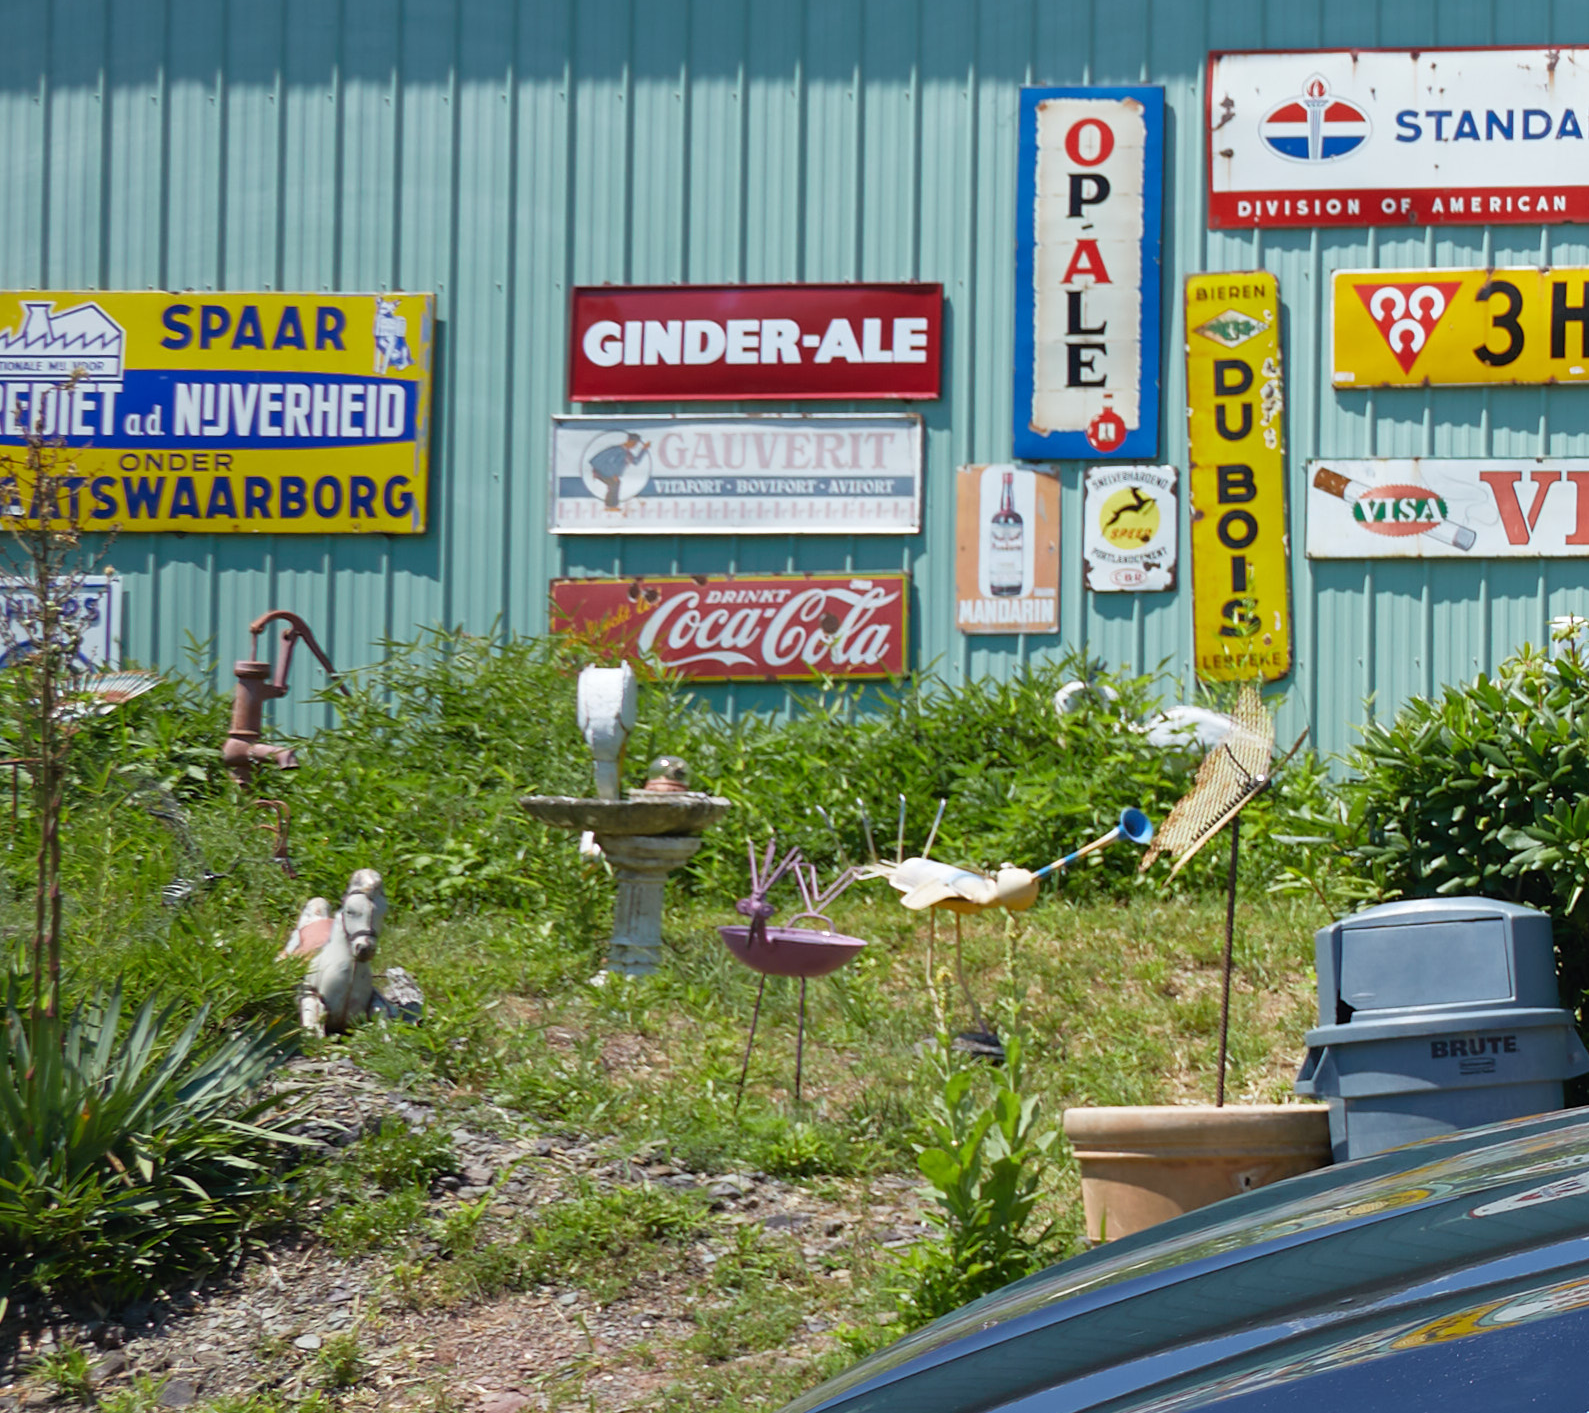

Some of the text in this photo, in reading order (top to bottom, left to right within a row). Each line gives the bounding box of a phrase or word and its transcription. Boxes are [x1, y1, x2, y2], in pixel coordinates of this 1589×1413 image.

[1237, 198, 1361, 218] DIVISION
[1381, 197, 1412, 216] OF
[1431, 194, 1567, 214] AMERICAN
[1195, 284, 1267, 302] BIEREN
[160, 304, 347, 351] SPAAR
[1473, 280, 1525, 367] 3
[582, 317, 929, 367] GINDER-ALE
[0, 382, 124, 436] EDIET
[174, 383, 407, 438] NIJVERHEID
[119, 453, 235, 472] ONDER
[657, 431, 896, 471] GAUVERIT
[1357, 497, 1446, 523] VISA
[705, 589, 791, 605] DRINKT
[958, 597, 1055, 625] MANDARIN
[637, 586, 901, 667] Coca-Cola
[1430, 1035, 1518, 1059] BRUTE
